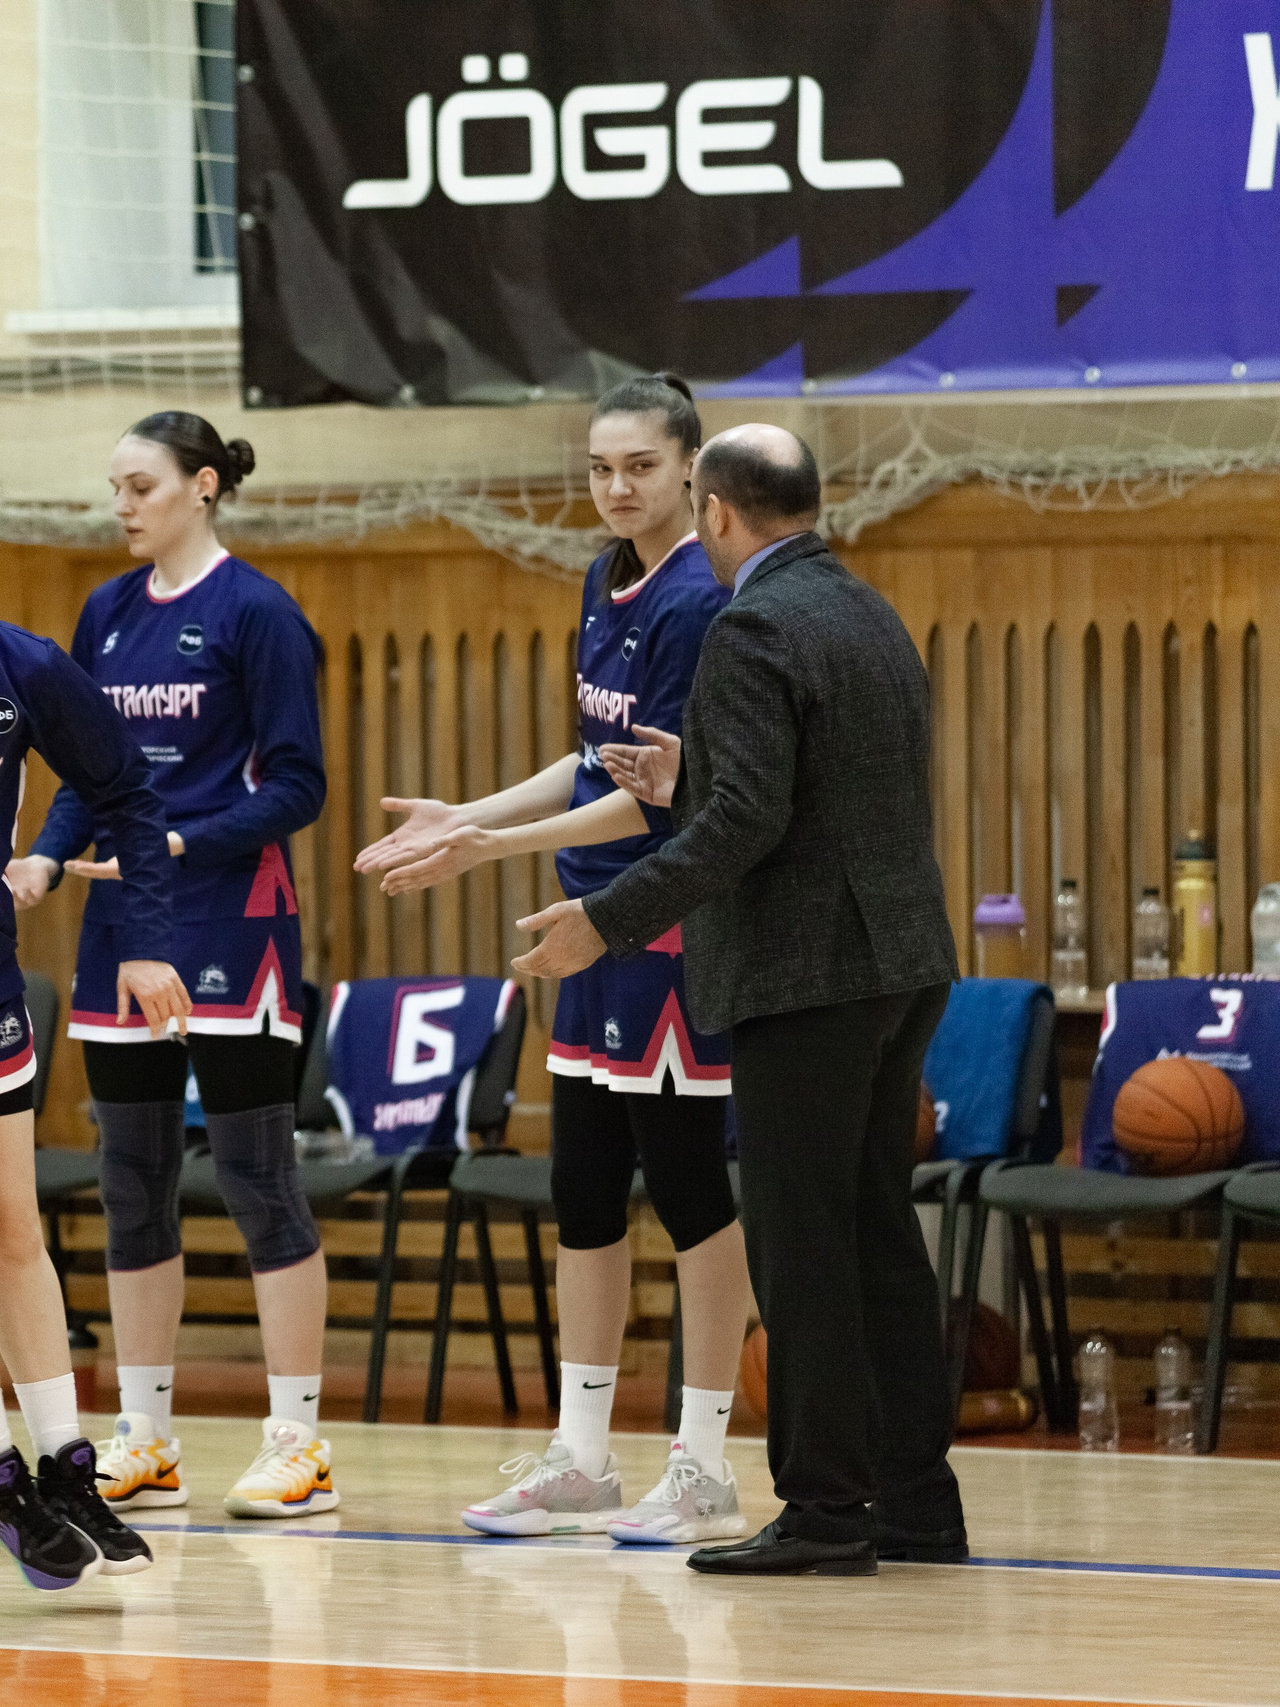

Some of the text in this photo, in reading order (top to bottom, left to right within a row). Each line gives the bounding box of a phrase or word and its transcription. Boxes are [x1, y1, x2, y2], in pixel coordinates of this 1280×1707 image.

[342, 52, 905, 209] JÖGEL
[101, 683, 207, 719] ТАЛЛУРГ
[1196, 987, 1243, 1041] 3
